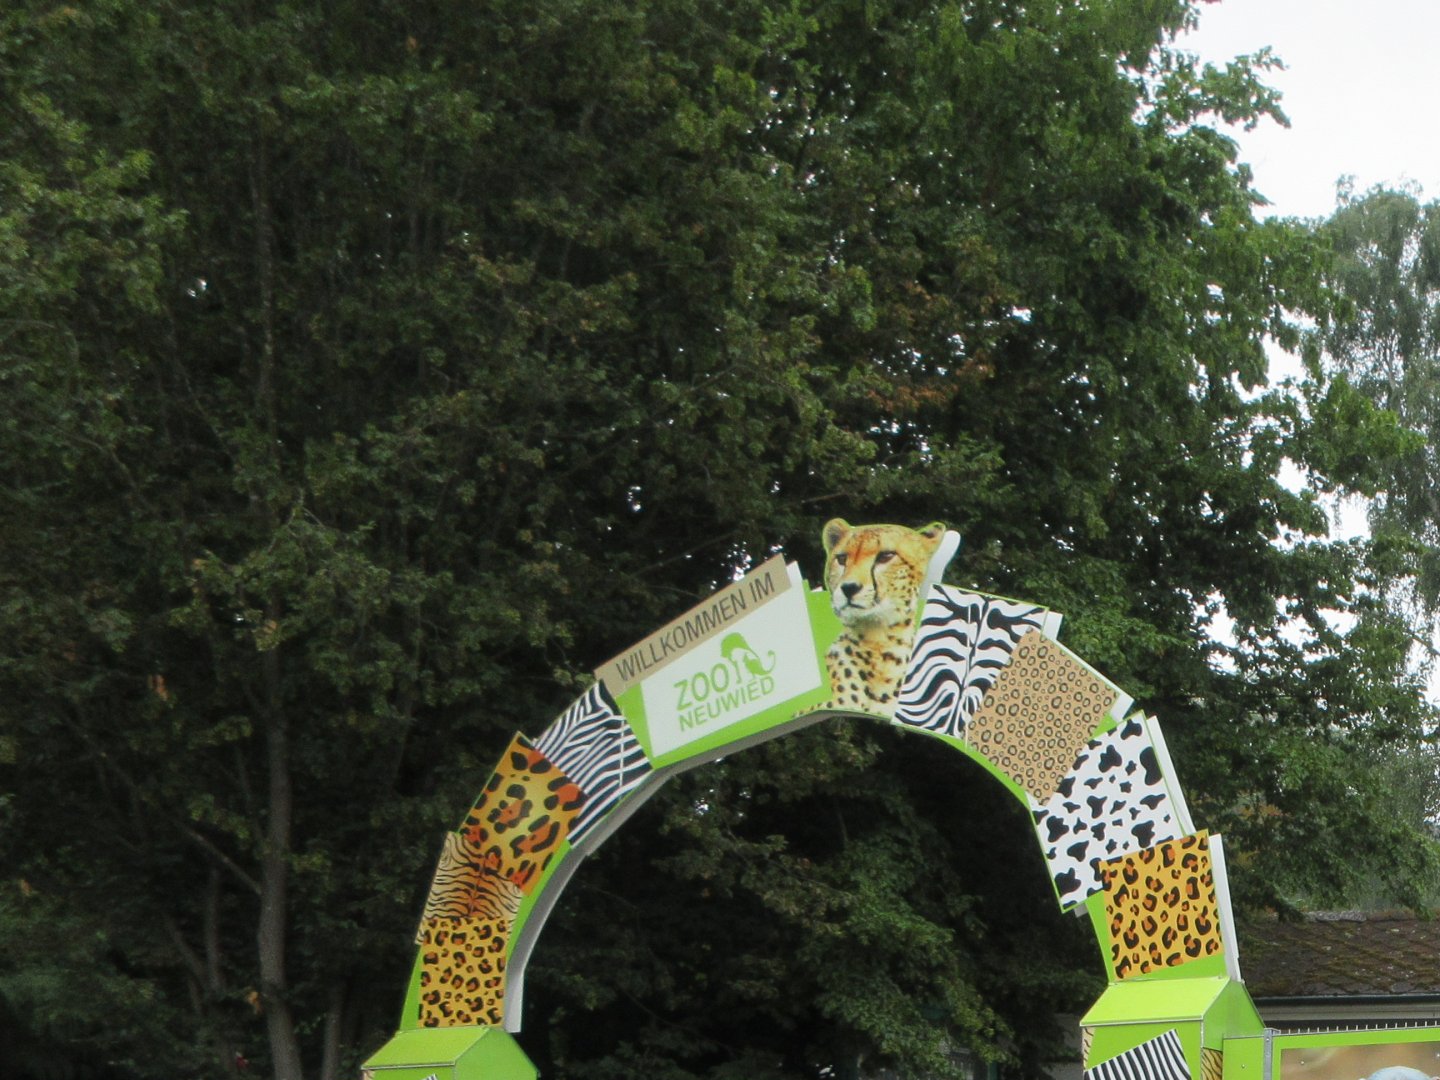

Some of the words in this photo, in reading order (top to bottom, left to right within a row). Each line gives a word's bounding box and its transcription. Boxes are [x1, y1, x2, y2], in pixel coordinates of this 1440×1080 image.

[616, 588, 747, 681] WILLKOMMEN
[750, 571, 775, 603] IM
[674, 663, 730, 711] ZOO
[679, 676, 775, 731] NEUWIED
